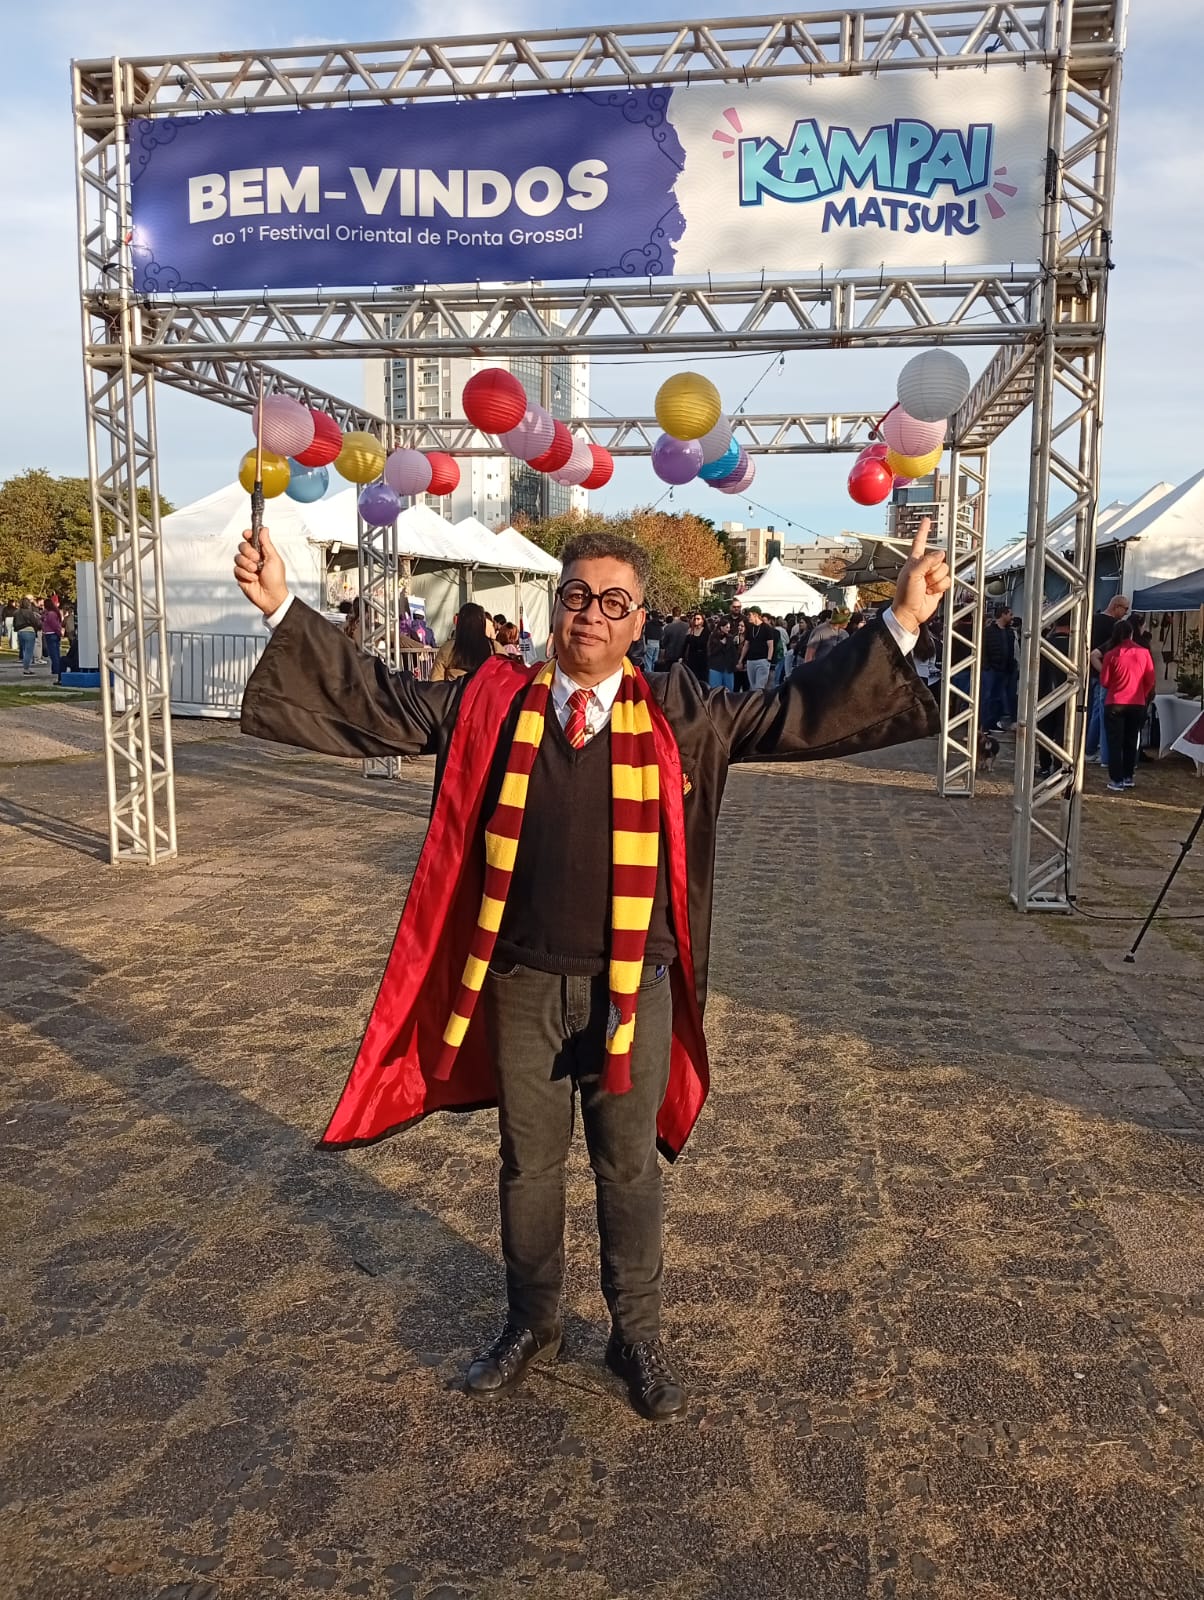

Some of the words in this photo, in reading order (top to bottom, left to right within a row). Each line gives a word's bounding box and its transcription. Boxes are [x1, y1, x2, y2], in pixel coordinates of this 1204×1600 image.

[188, 158, 609, 225] BEM-VINDOS
[738, 117, 994, 207] KAMPAI
[212, 232, 236, 246] ao
[258, 223, 332, 241] Festival
[335, 224, 412, 244] Oriental
[417, 228, 441, 245] de
[446, 229, 503, 246] Ponta
[508, 222, 584, 245] Grossa!
